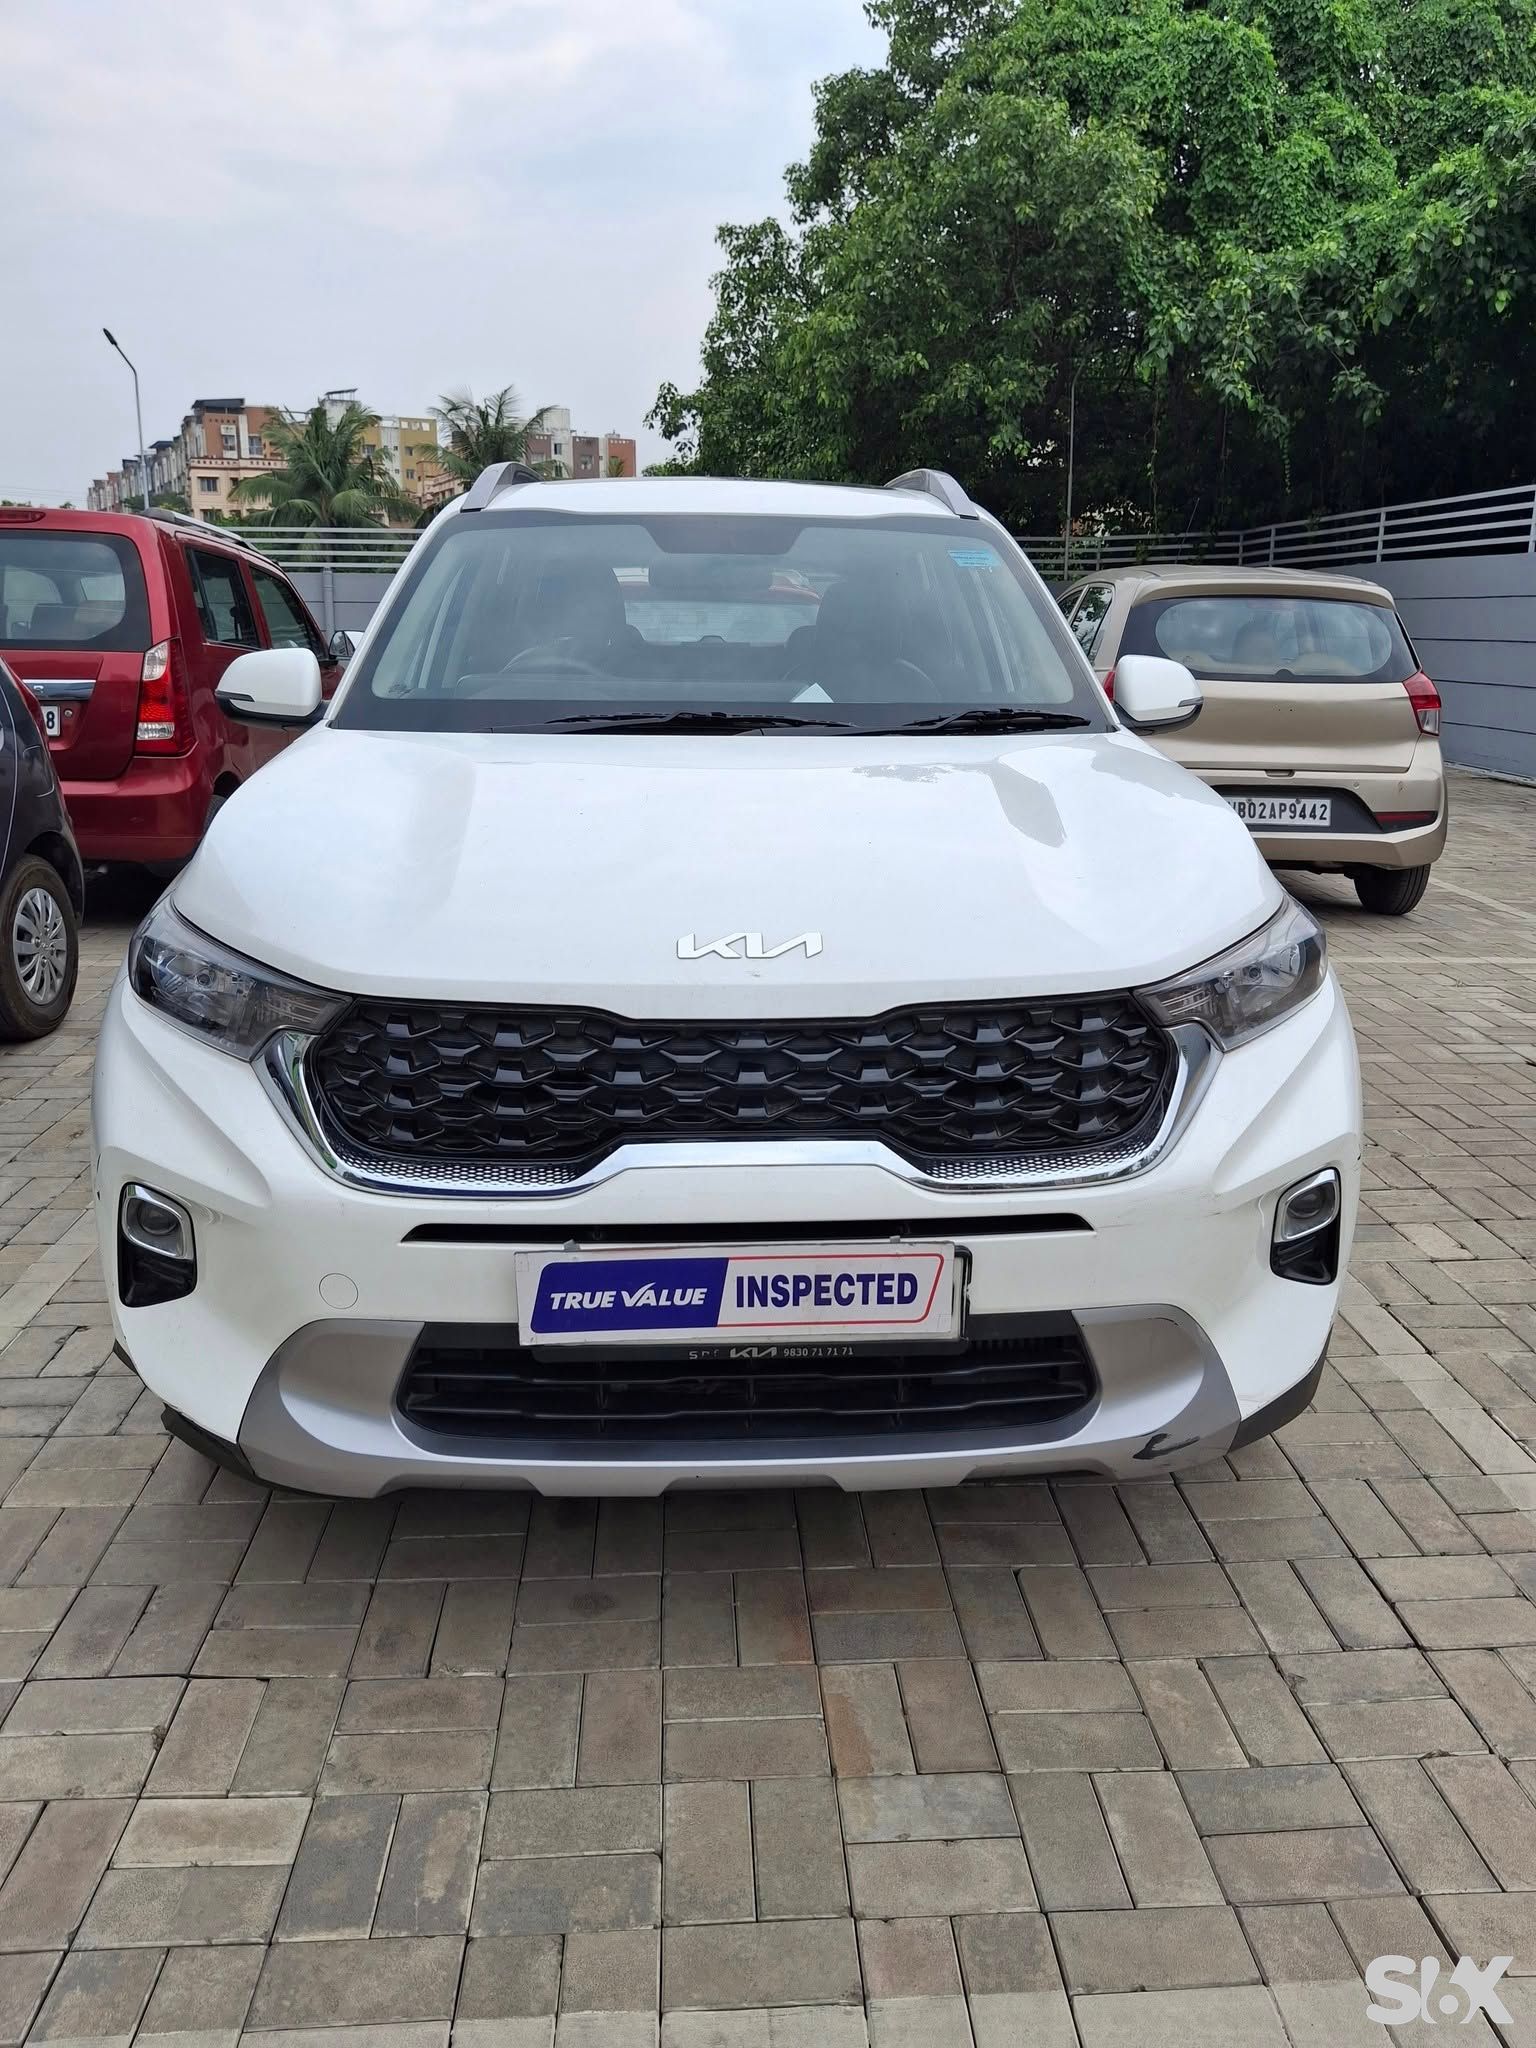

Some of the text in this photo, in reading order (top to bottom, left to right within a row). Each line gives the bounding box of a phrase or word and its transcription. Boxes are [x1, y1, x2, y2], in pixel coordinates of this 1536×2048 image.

[550, 1272, 918, 1310] TRUE VALUE INSPECTED
[784, 1348, 808, 1357] 9830
[812, 1348, 822, 1356] 71
[827, 1347, 838, 1356] 71
[842, 1346, 853, 1355] 71
